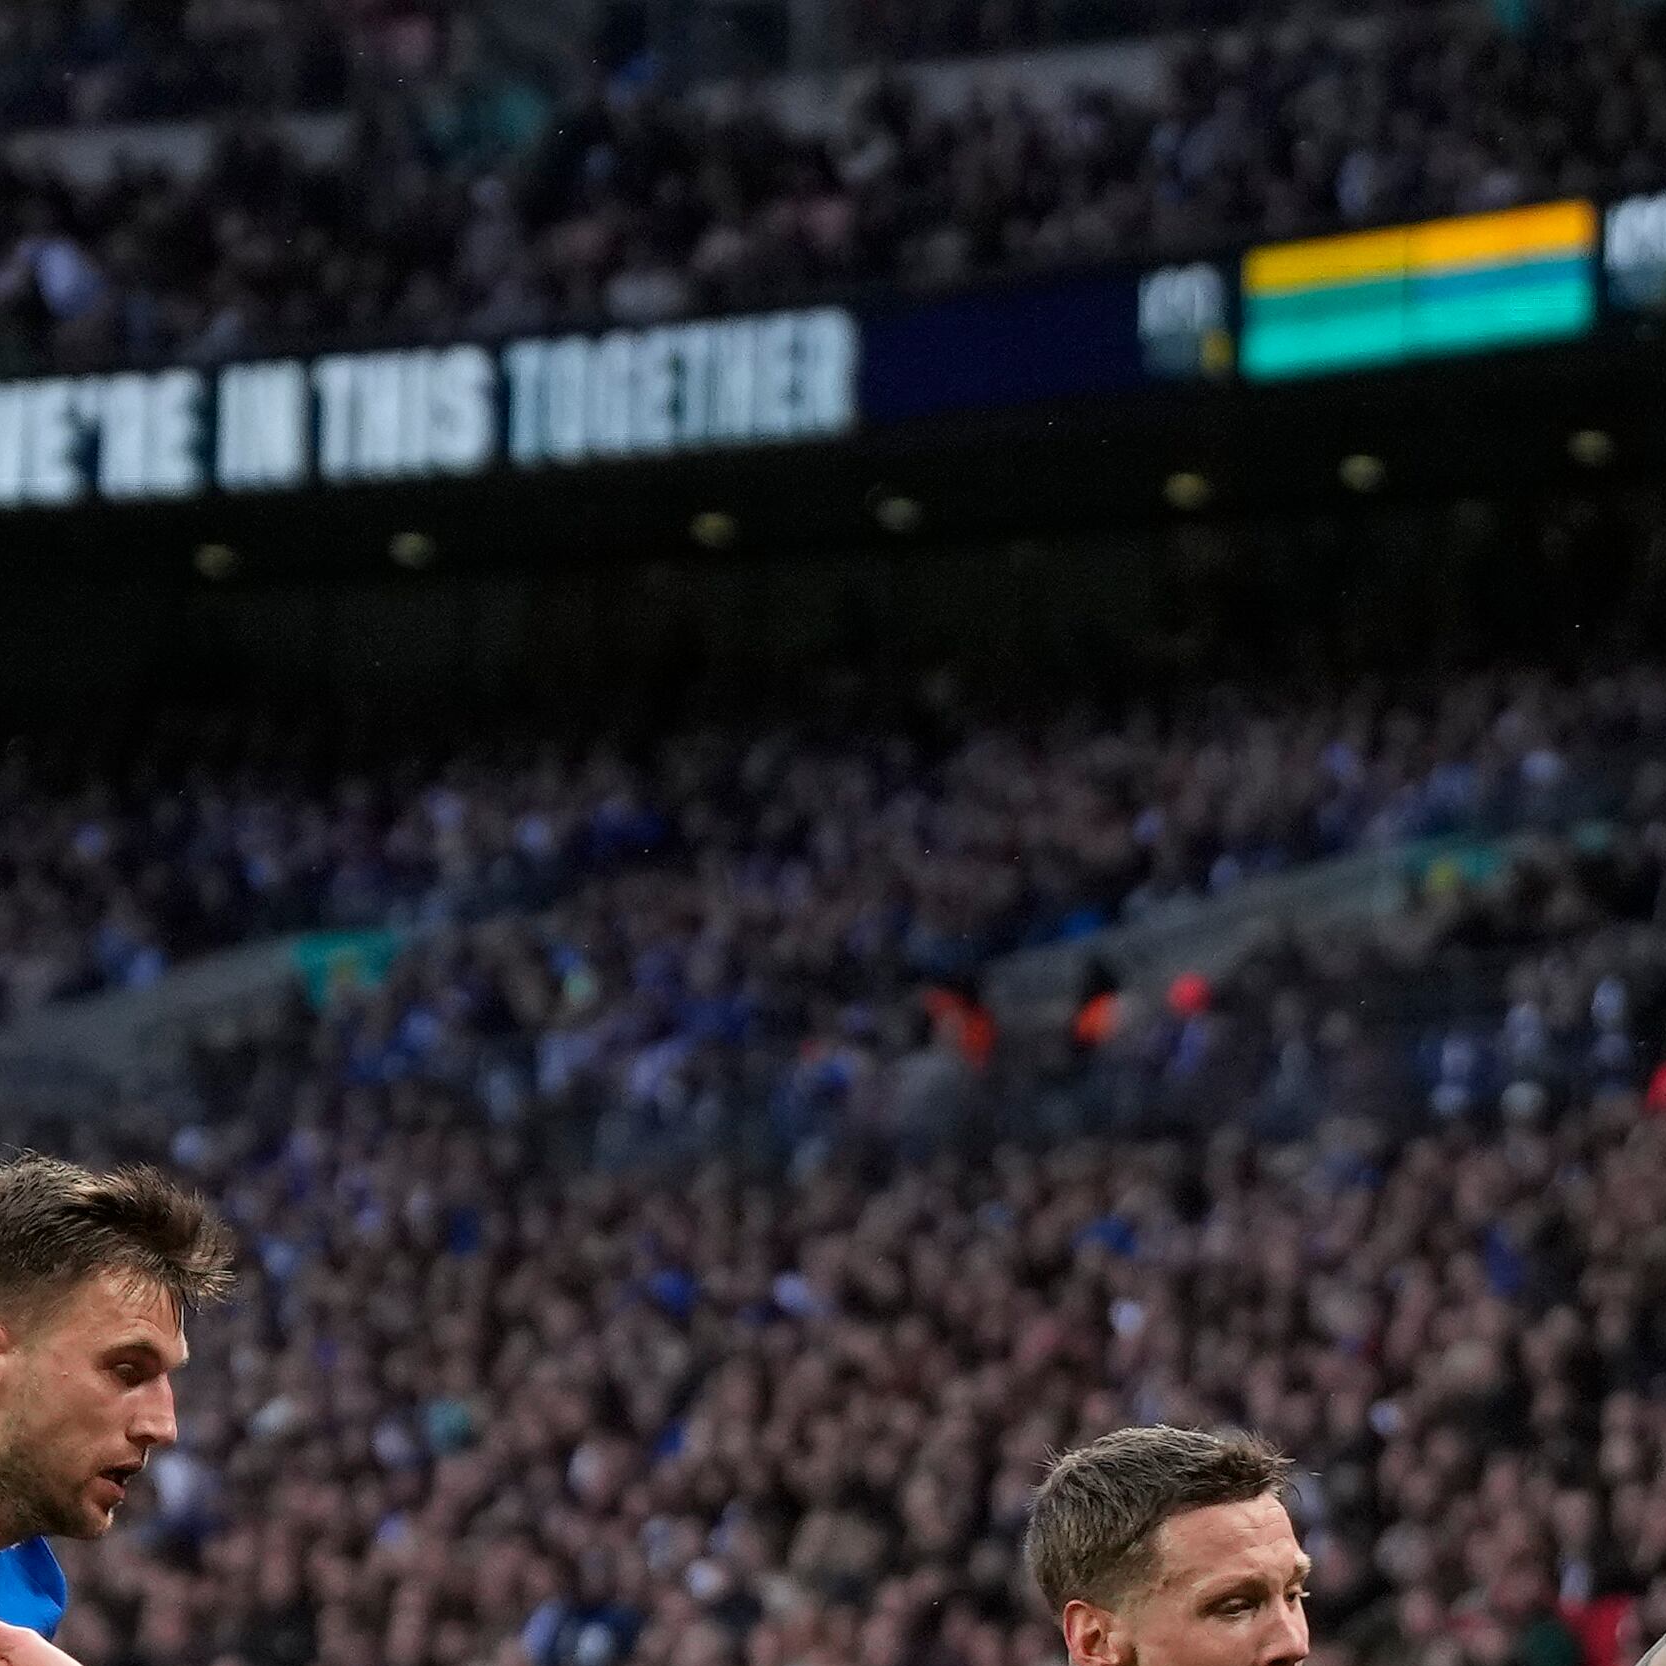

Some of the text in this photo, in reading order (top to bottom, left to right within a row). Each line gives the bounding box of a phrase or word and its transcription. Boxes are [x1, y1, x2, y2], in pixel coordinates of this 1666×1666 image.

[215, 358, 307, 495] IN
[314, 344, 496, 481] THIS
[508, 304, 858, 467] TOGETHER
